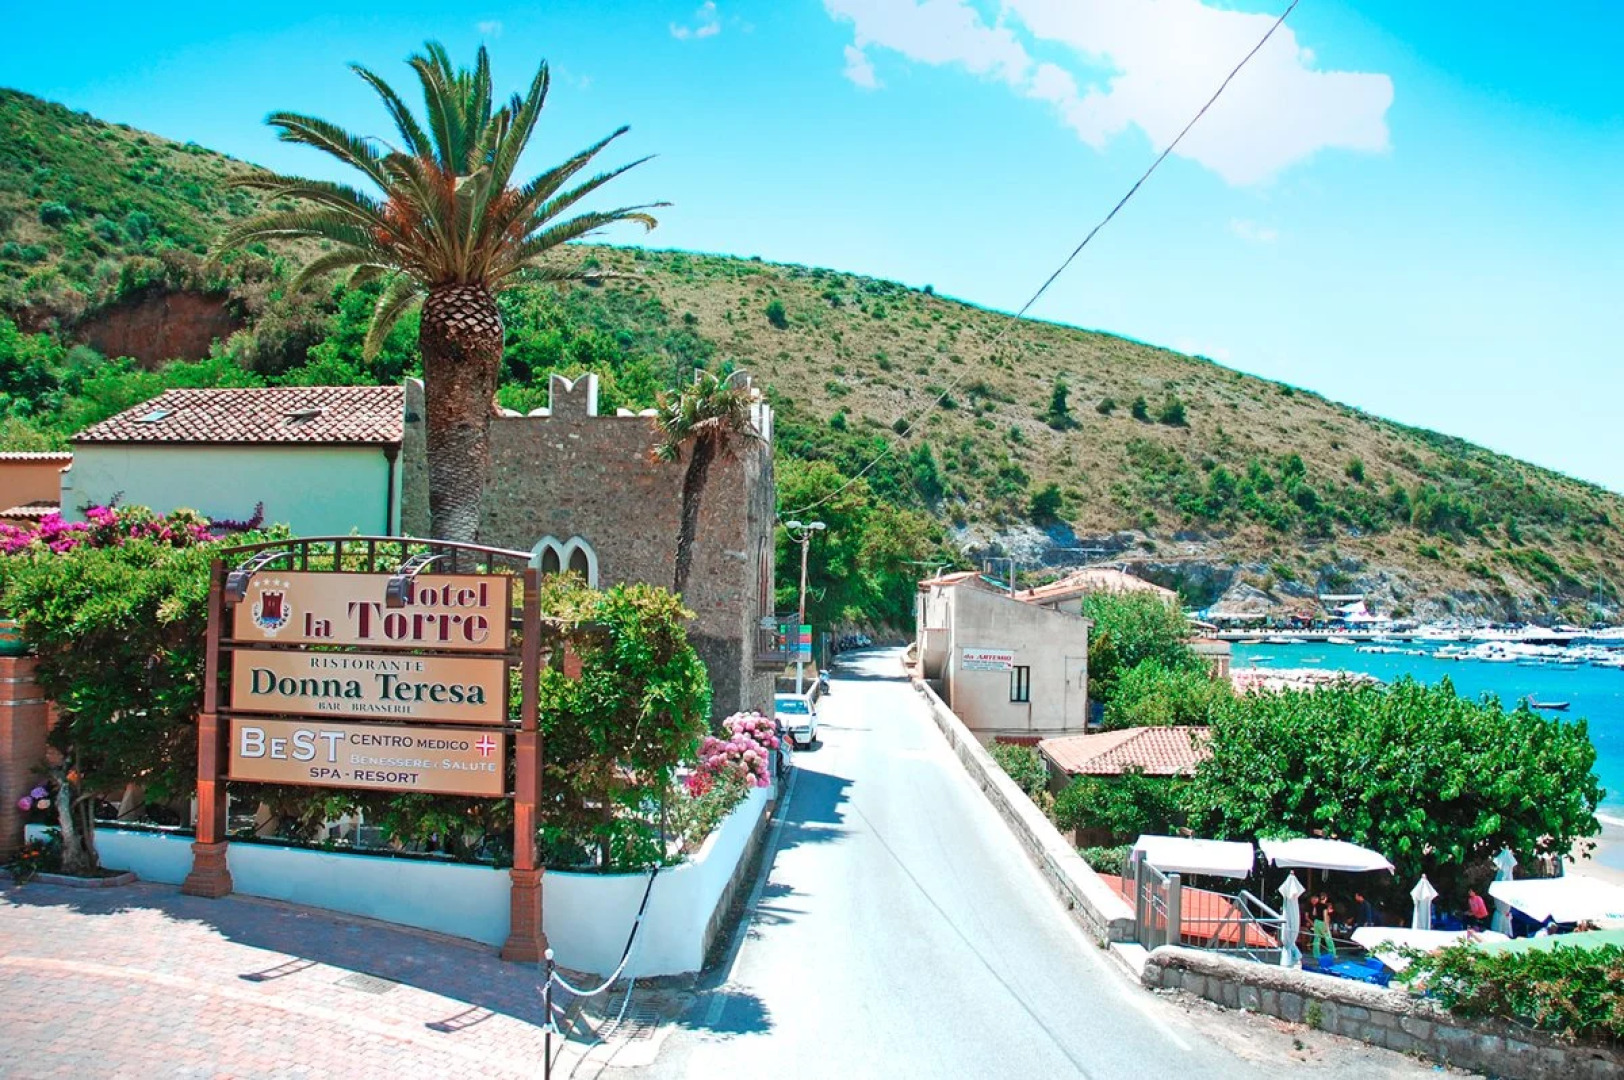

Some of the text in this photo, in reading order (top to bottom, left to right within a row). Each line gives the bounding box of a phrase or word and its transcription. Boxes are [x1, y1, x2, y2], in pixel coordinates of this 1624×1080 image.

[303, 601, 489, 644] la Torre
[310, 657, 424, 672] RISTORANTE
[251, 667, 487, 705] Donna Teresa
[318, 701, 412, 714] BAR BRASSERIE
[350, 733, 469, 751] CENTRO MEDICO
[442, 758, 496, 773] SALUTE
[309, 767, 342, 780] SPA
[354, 769, 420, 784] RESORT
